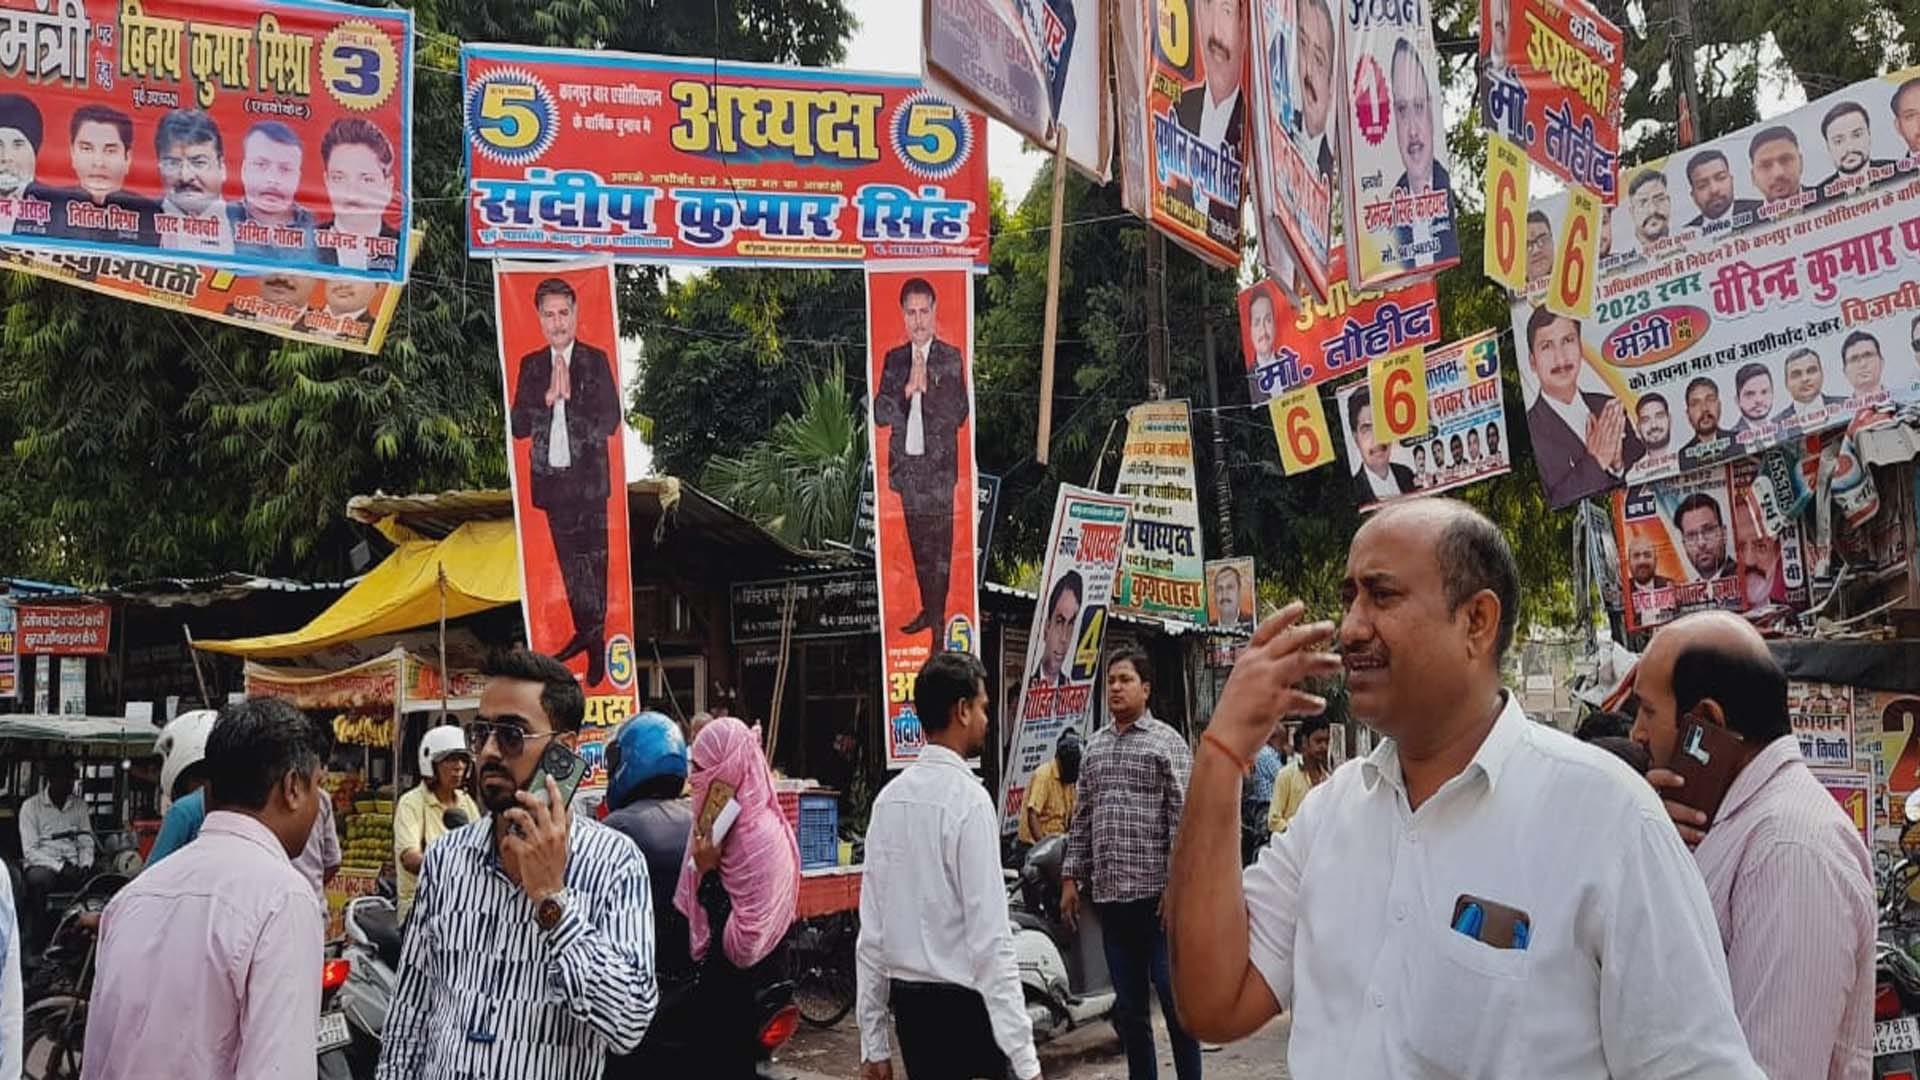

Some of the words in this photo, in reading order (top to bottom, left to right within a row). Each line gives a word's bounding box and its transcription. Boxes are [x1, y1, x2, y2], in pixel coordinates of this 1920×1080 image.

[0, 0, 90, 82] मंत्री
[190, 20, 252, 108] कुमार
[259, 11, 313, 95] मिश्रा
[332, 46, 381, 95] 3
[1525, 10, 1610, 118] उपाध्यक्ष
[481, 84, 541, 149] 5
[671, 80, 883, 162] अध्यक्ष
[906, 104, 957, 164] 5
[236, 221, 269, 245] अमित
[476, 169, 656, 231] संदीप
[674, 189, 840, 245] कुमार
[855, 186, 972, 241] सिंह
[1496, 169, 1517, 277] 6
[364, 235, 397, 259] गुप्ता
[1561, 214, 1589, 308] 6
[1596, 290, 1651, 324] 2023
[1655, 271, 1703, 303] रनर
[1802, 225, 1897, 302] कुमार
[1256, 346, 1314, 393] मो.
[1472, 339, 1499, 379] 3
[1613, 317, 1671, 359] मंत्री
[1650, 362, 1688, 386] अपना
[1692, 353, 1713, 371] मत
[1740, 324, 1803, 359] आशीर्वाद
[1807, 316, 1841, 338] देकर
[1383, 368, 1417, 435] 6
[1286, 405, 1320, 466] 6
[610, 643, 632, 683] 5
[1073, 607, 1104, 676] 4
